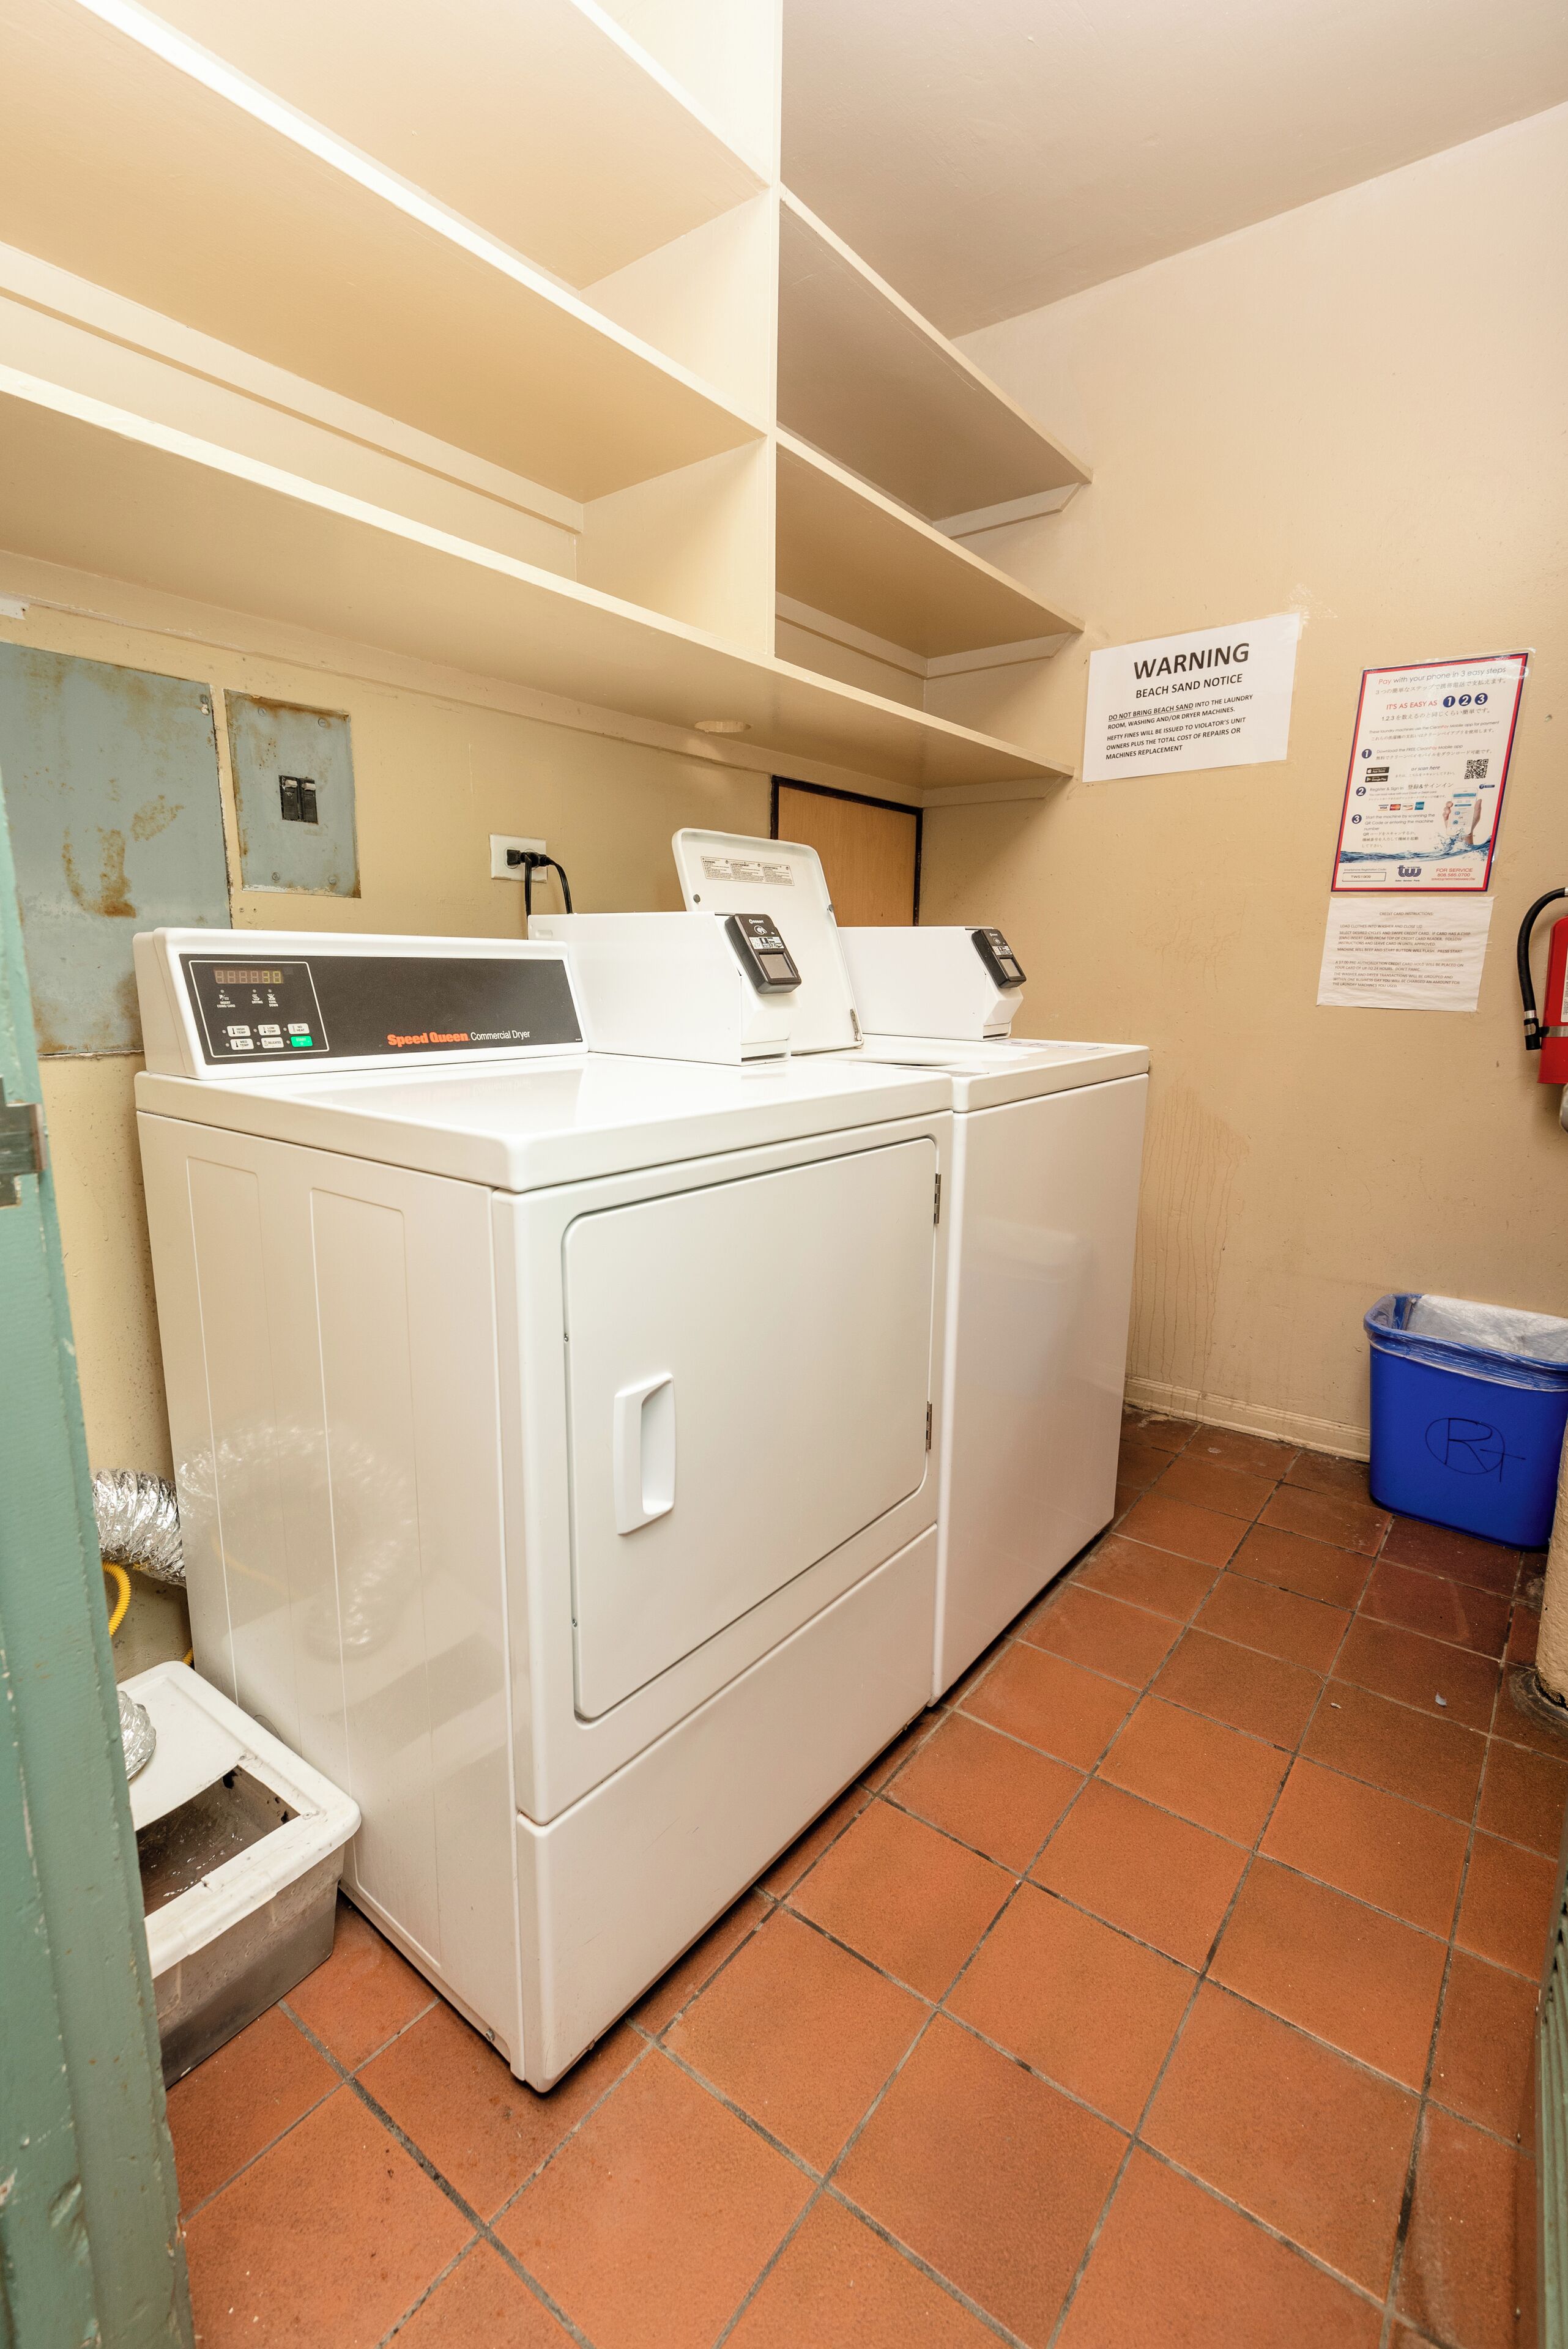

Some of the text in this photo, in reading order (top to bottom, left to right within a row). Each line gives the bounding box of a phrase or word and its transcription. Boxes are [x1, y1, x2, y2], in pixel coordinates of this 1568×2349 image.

[1134, 642, 1249, 680] WARNING
[1426, 672, 1451, 681] phone
[1136, 674, 1243, 699] BEACH SAND NOTICE
[1224, 694, 1253, 703] LAUNDRY
[1460, 695, 1470, 706] 2
[1476, 694, 1486, 705] 3
[1128, 718, 1155, 727] WASHING
[1202, 707, 1235, 716] MACHINES.
[1194, 719, 1229, 729] VIOLATOR'S
[1106, 742, 1129, 751] OWNERS
[1202, 729, 1229, 738] REPAIRS
[1105, 744, 1183, 760] MACHINES REPLACEMENT
[1357, 787, 1365, 796] 2
[1353, 815, 1361, 823] 3
[387, 1030, 530, 1047] Speed Queen Commercial Dryer
